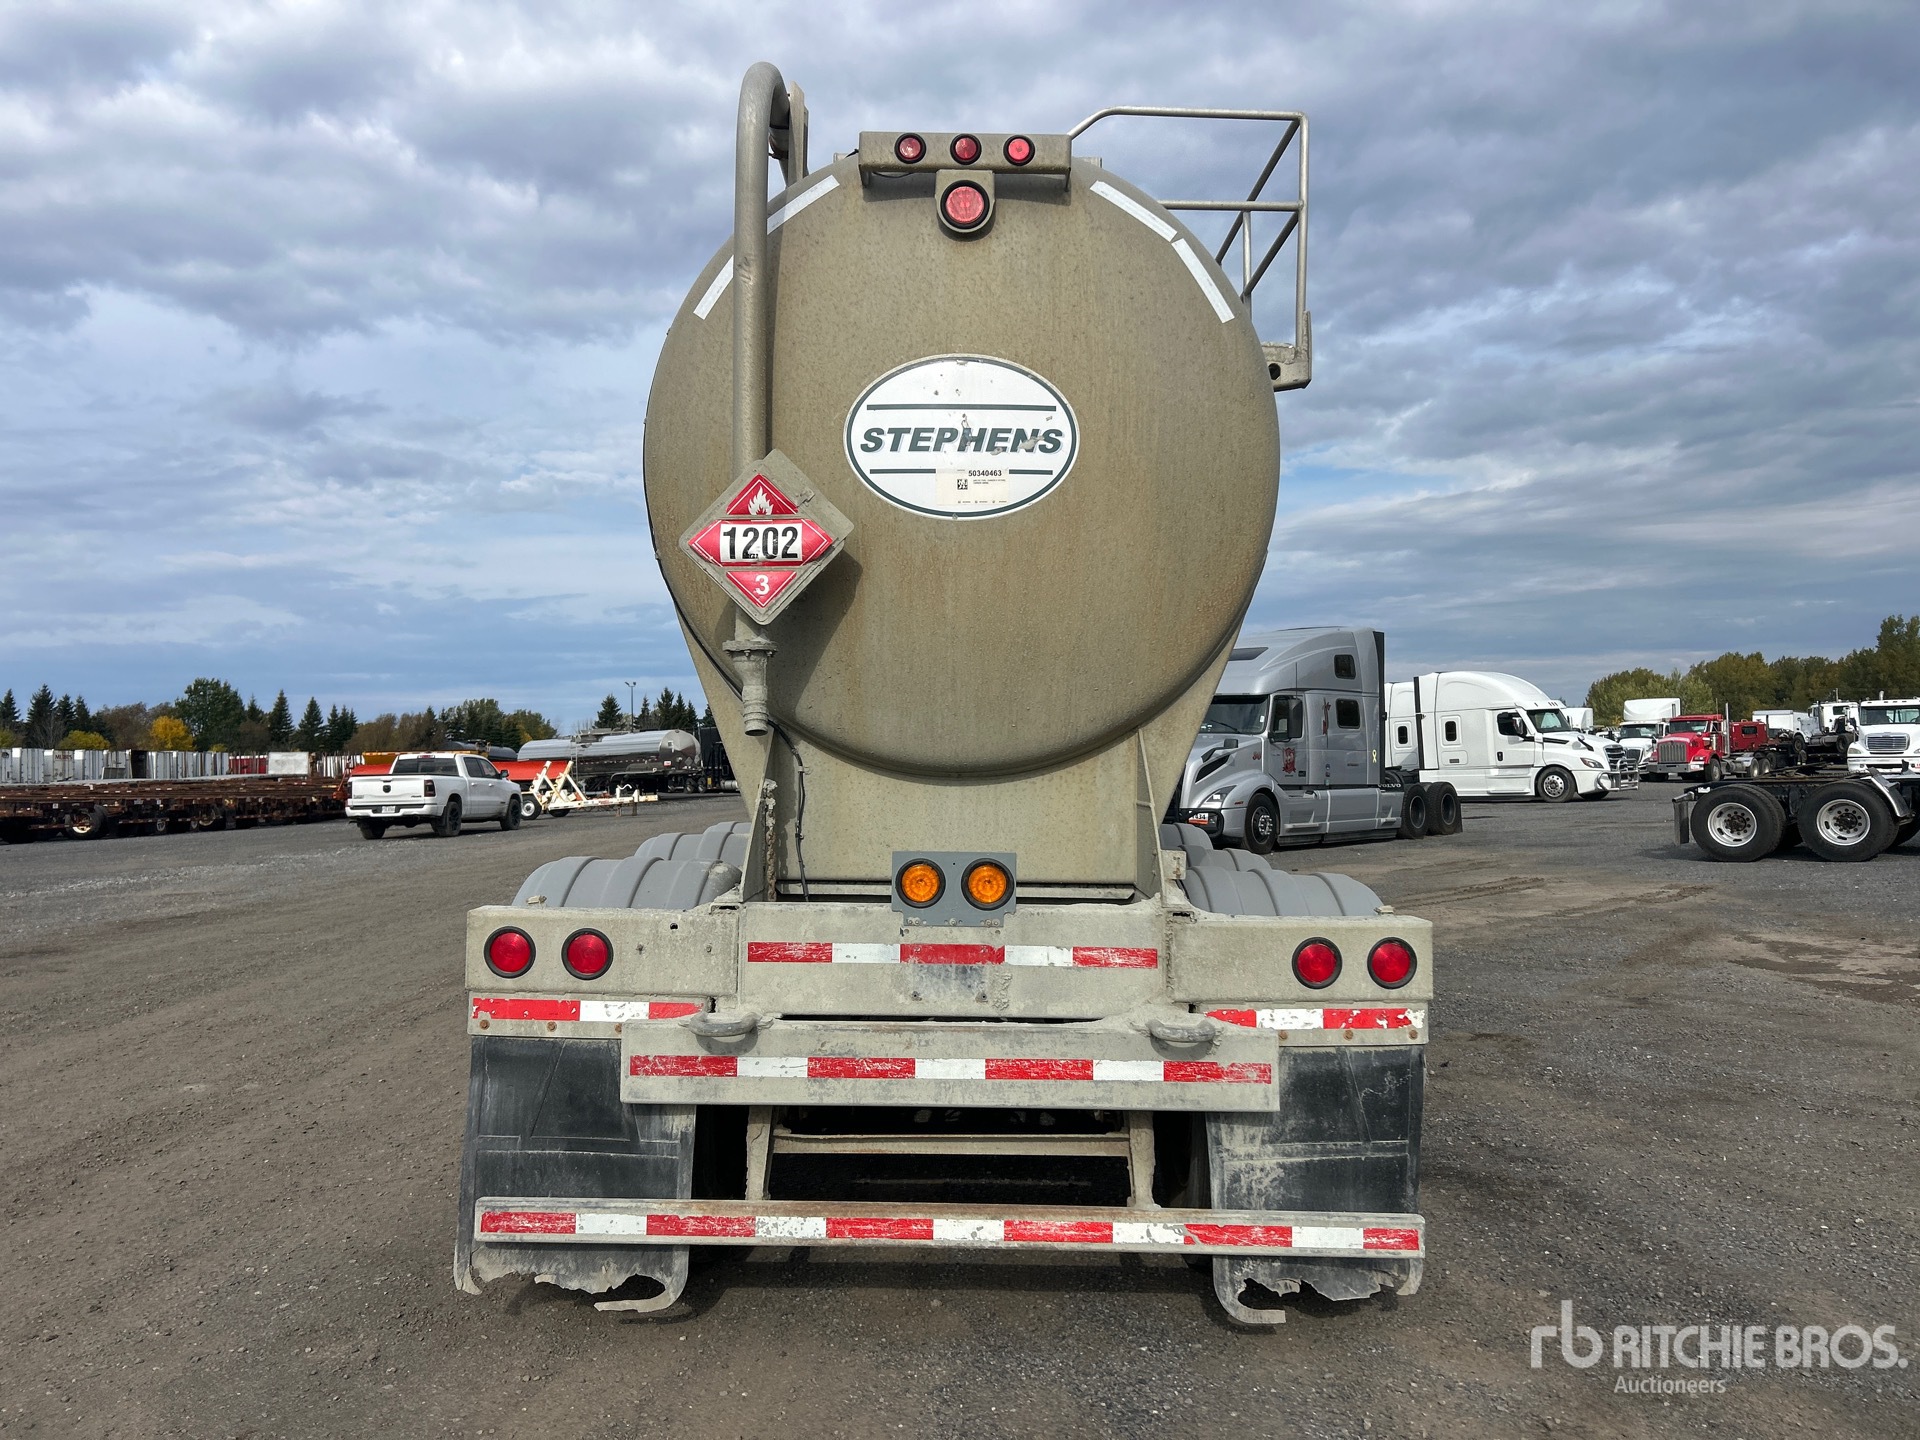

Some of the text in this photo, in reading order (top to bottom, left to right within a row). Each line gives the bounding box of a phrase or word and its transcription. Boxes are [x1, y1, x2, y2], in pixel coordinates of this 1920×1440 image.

[860, 427, 1064, 454] STEPHENS
[968, 469, 1002, 477] 50340463
[722, 526, 799, 560] 1202
[753, 574, 770, 595] 3
